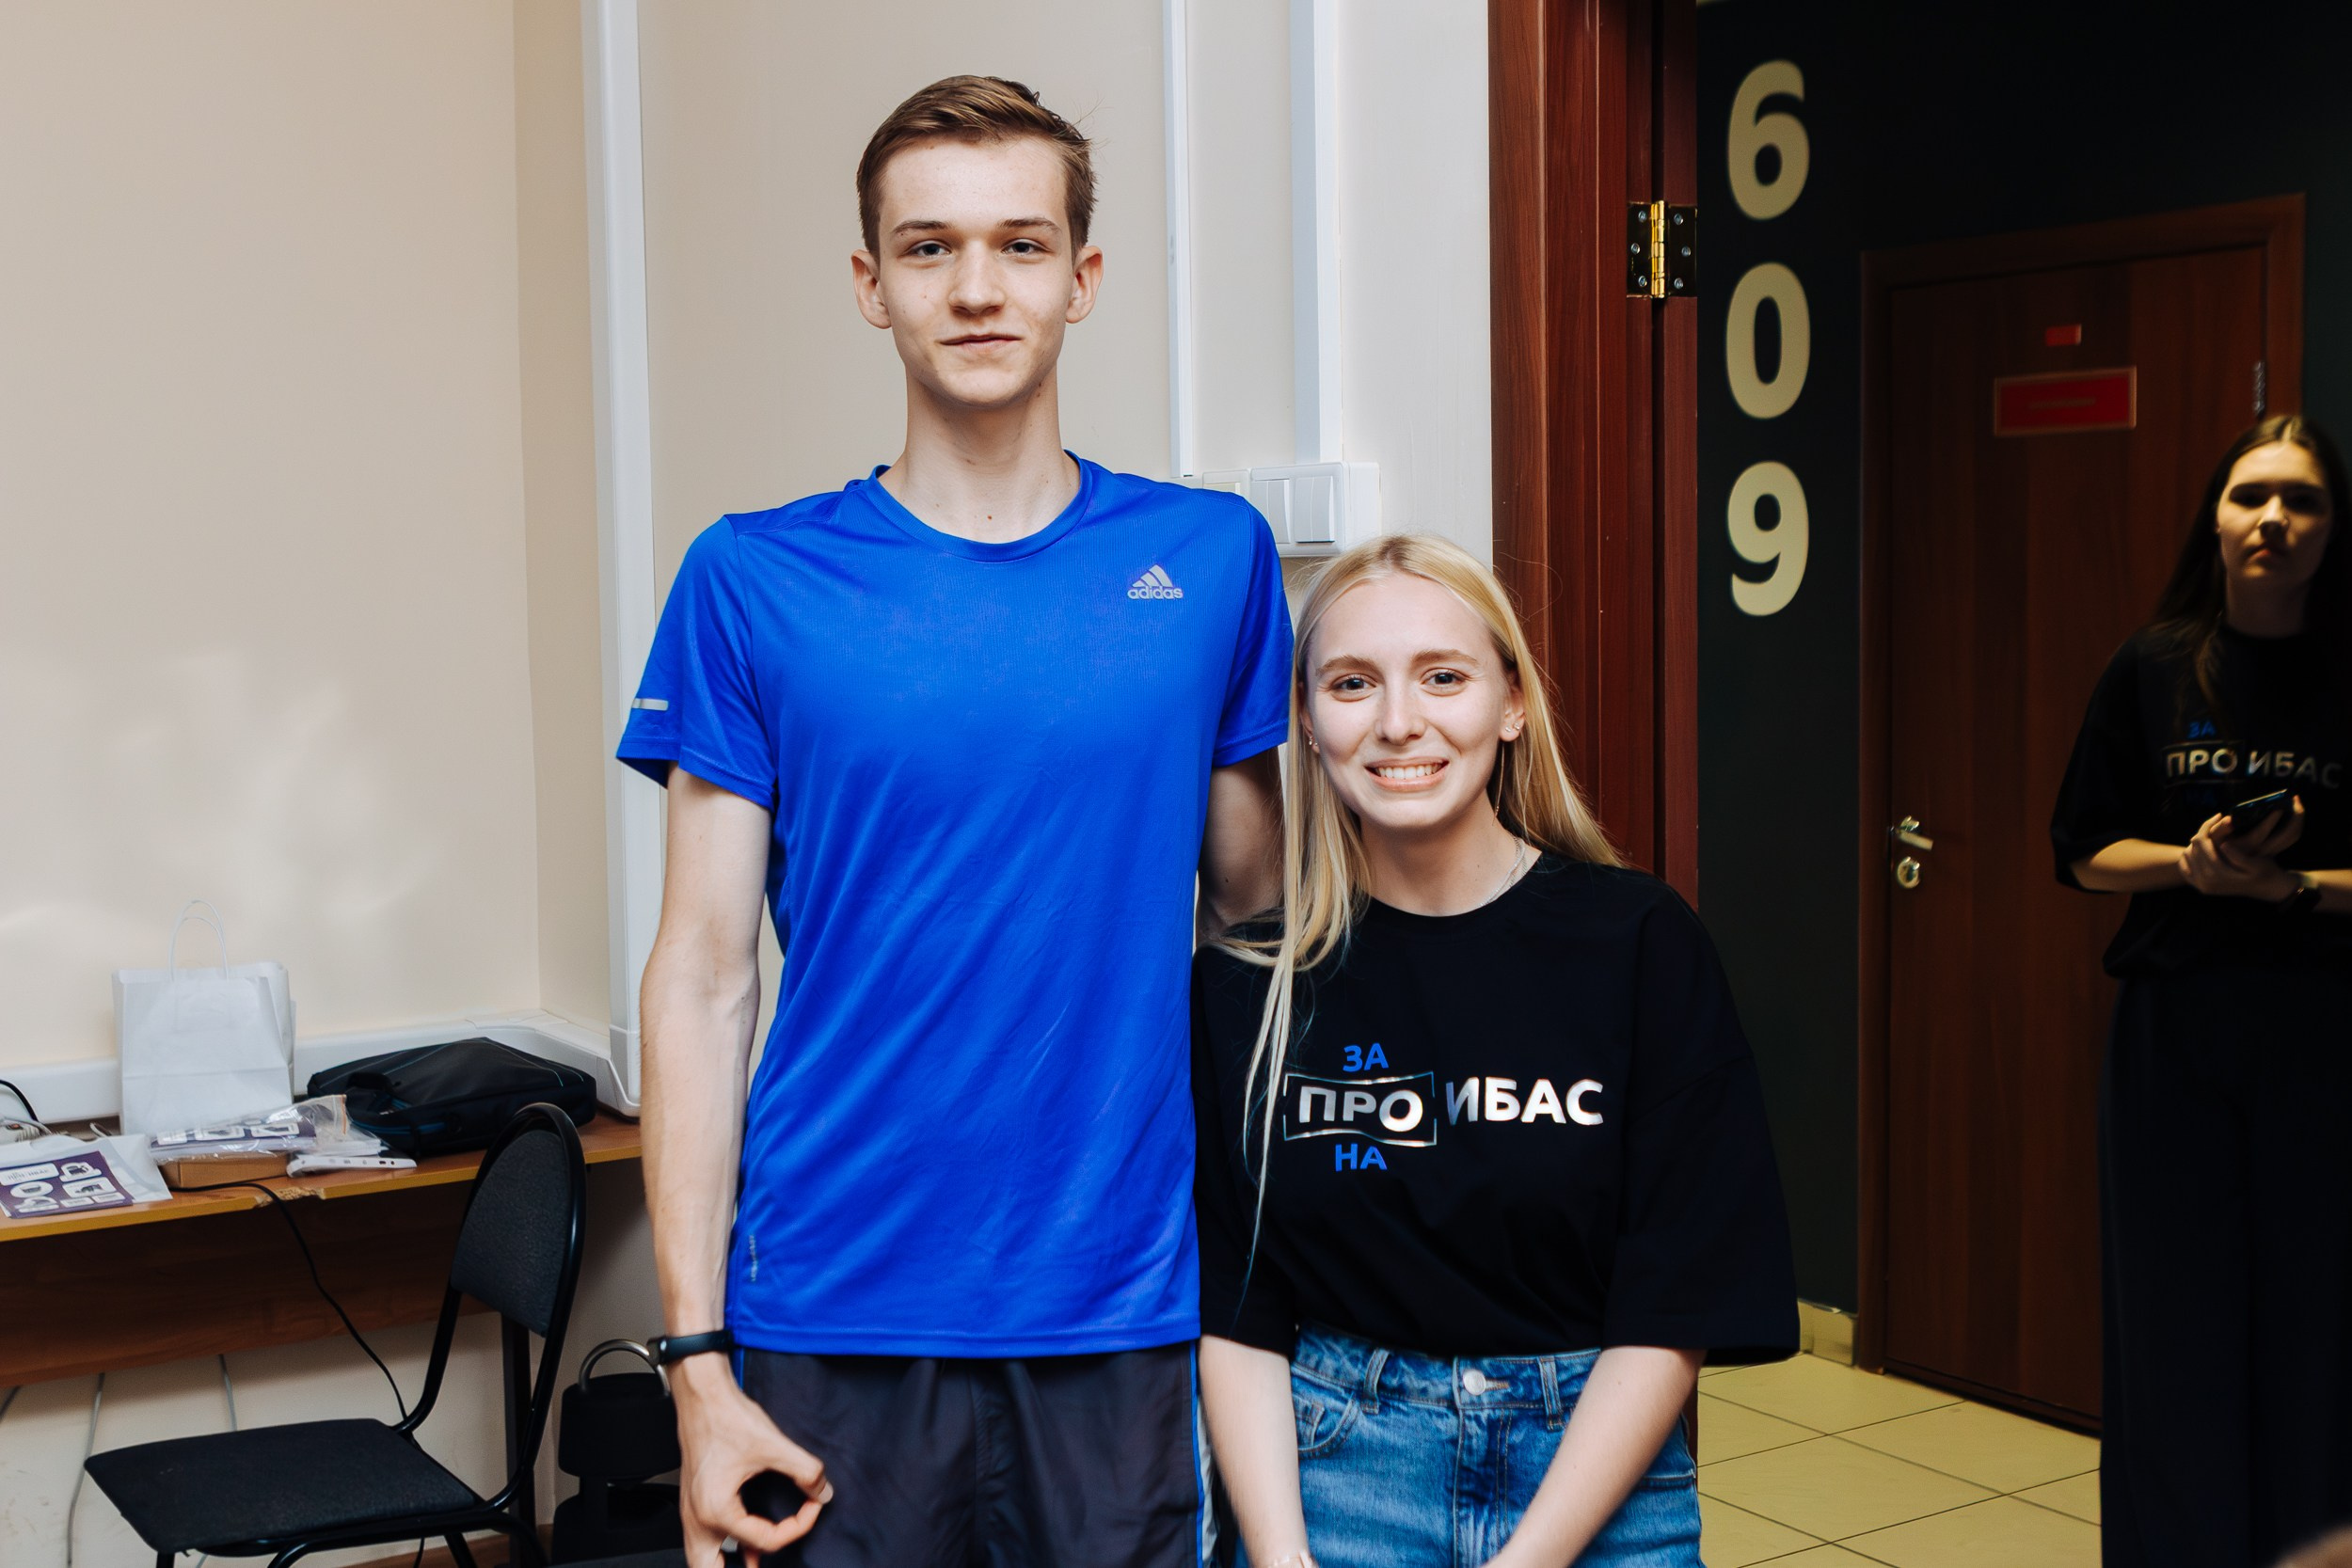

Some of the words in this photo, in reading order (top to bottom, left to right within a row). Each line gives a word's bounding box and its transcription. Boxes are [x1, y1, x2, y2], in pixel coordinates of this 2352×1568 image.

[1127, 585, 1184, 600] adidas
[2167, 749, 2238, 777] ПРО
[2247, 751, 2344, 790] ИБАС
[1343, 1042, 1390, 1072] ЗА
[1299, 1085, 1423, 1132] ПРО
[1445, 1076, 1604, 1126] ИБАС
[1334, 1143, 1388, 1172] НА
